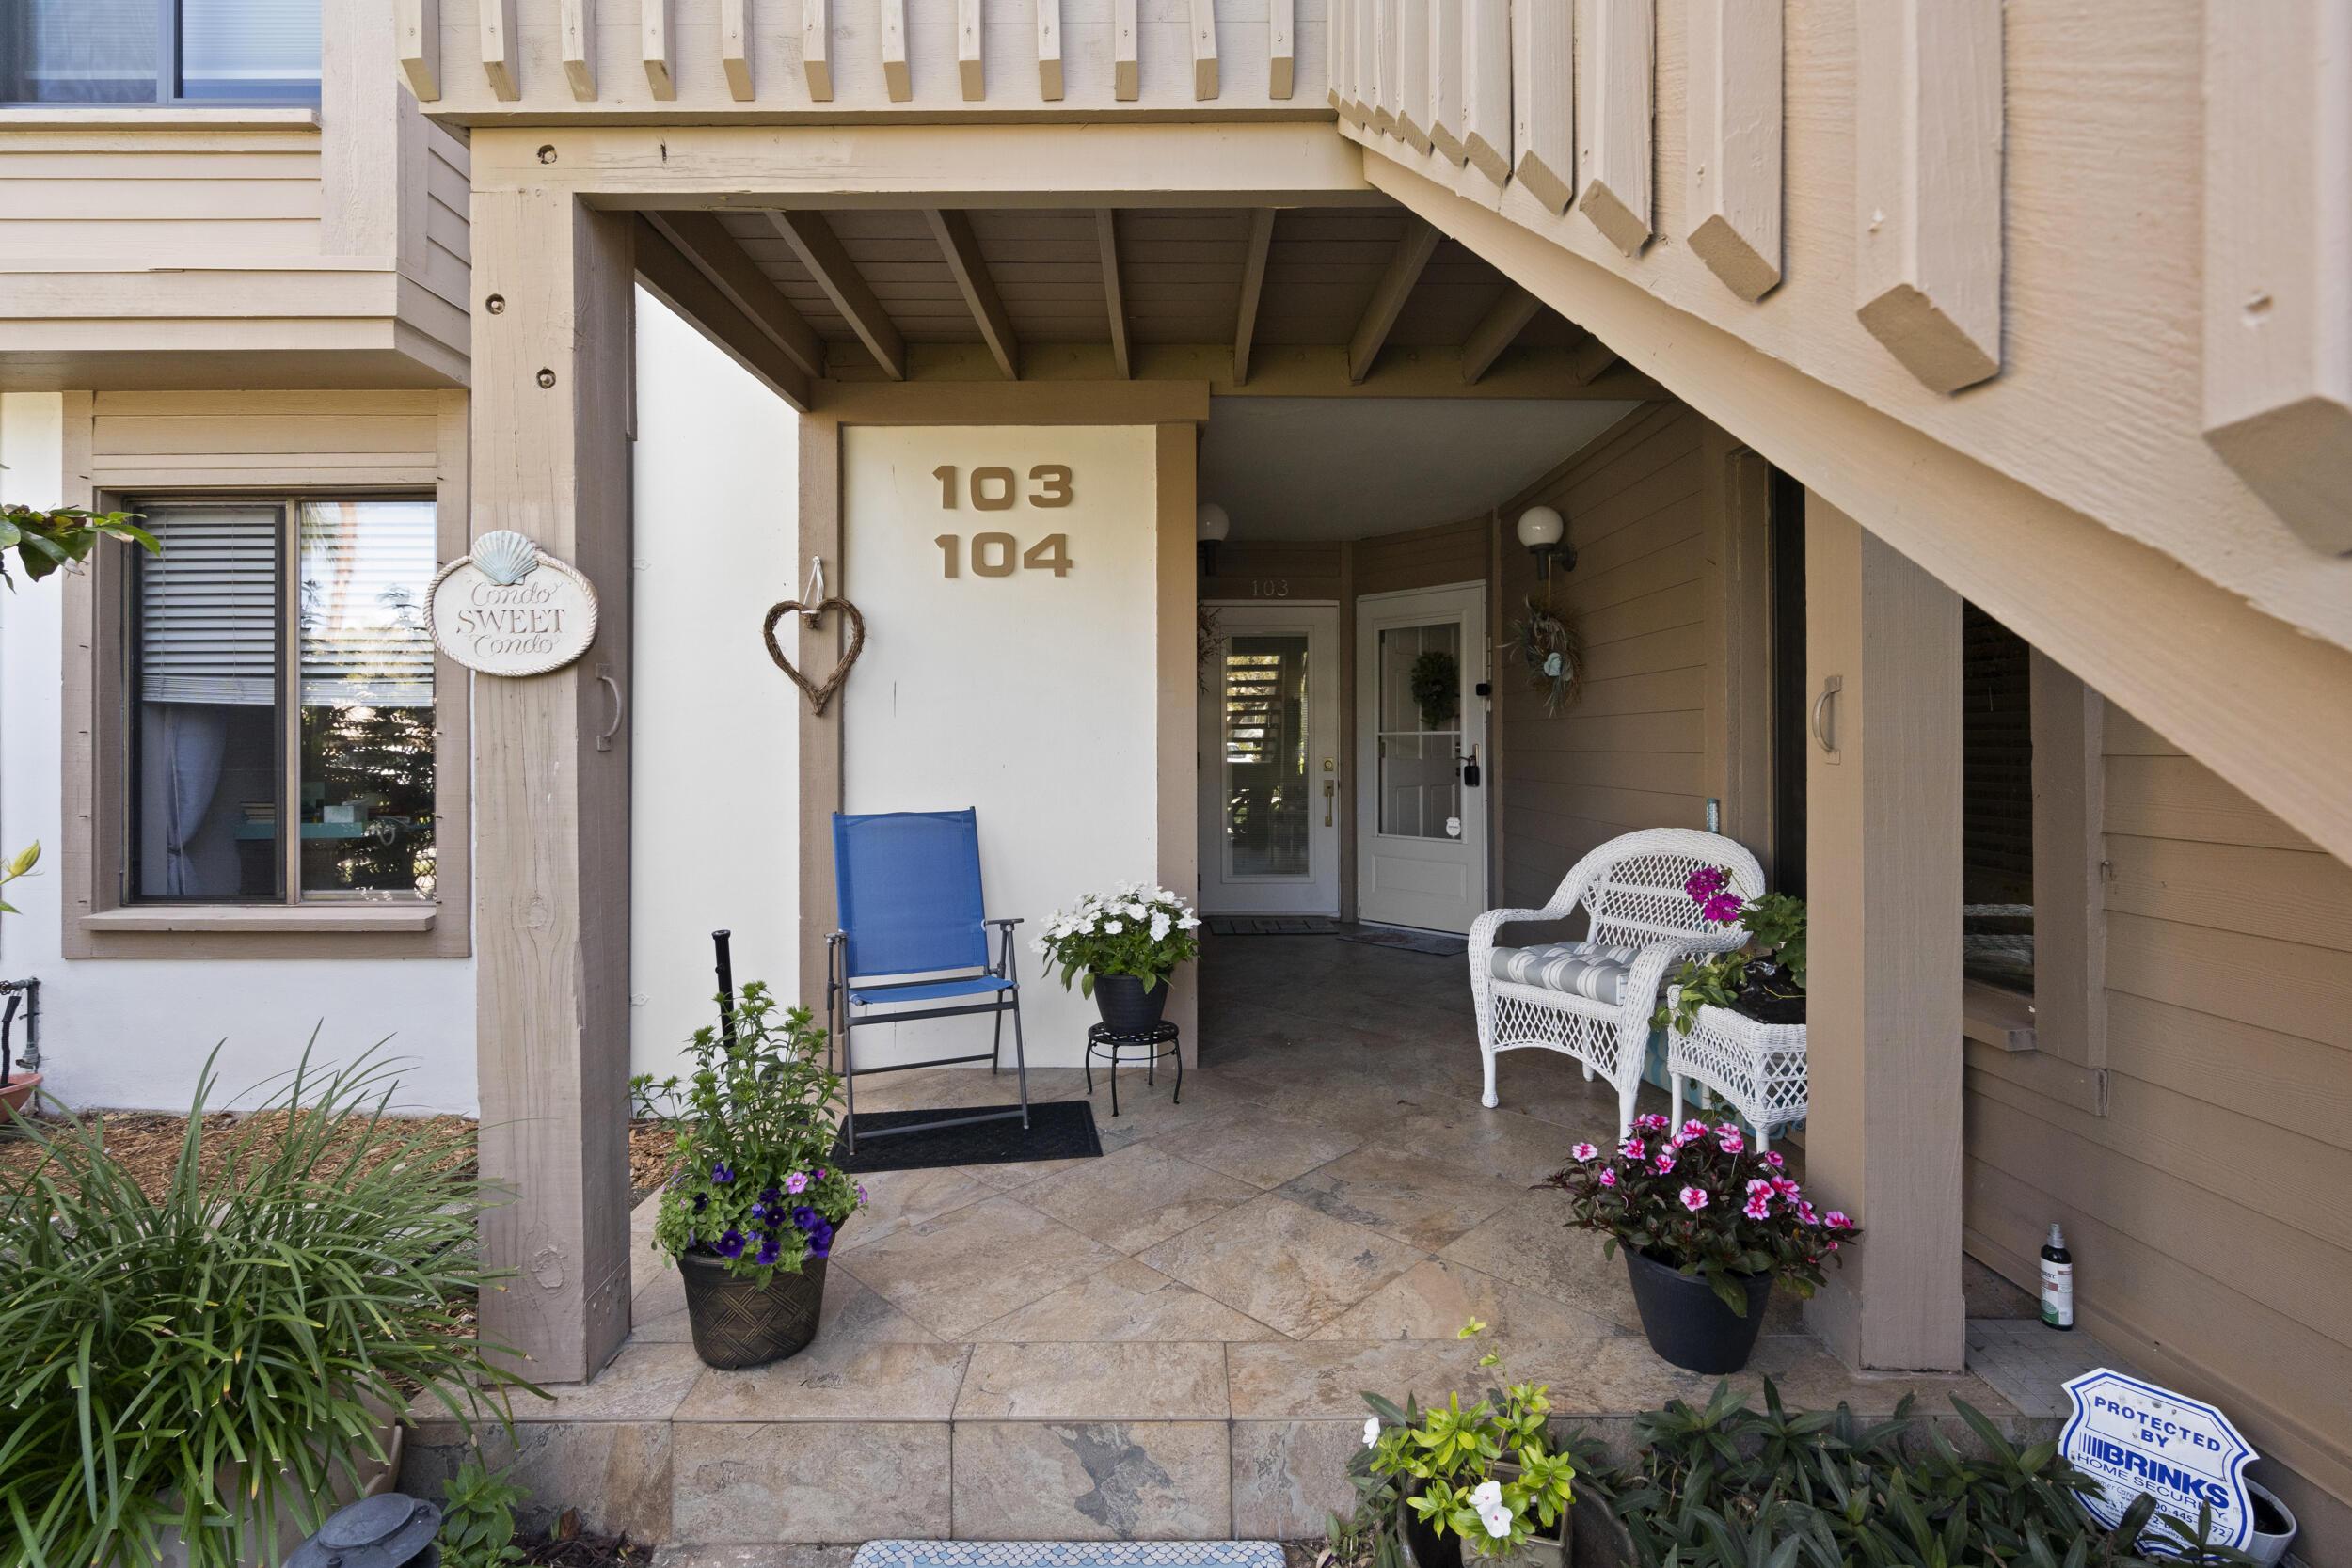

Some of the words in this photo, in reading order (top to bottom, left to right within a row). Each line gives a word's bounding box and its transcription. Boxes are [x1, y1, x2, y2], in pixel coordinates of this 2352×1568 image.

[932, 464, 1073, 511] 103
[934, 532, 1073, 578] 104
[469, 581, 563, 607] Condo
[1251, 579, 1289, 596] 103
[456, 609, 565, 634] SWEET
[473, 634, 561, 658] Condo
[2093, 1396, 2221, 1452] PROTECTED
[2140, 1428, 2169, 1449] BY
[2077, 1453, 2128, 1481] HOME
[2133, 1476, 2227, 1519] SECURIY
[2103, 1442, 2230, 1509] BRINKS
[2116, 1486, 2135, 1497] Care
